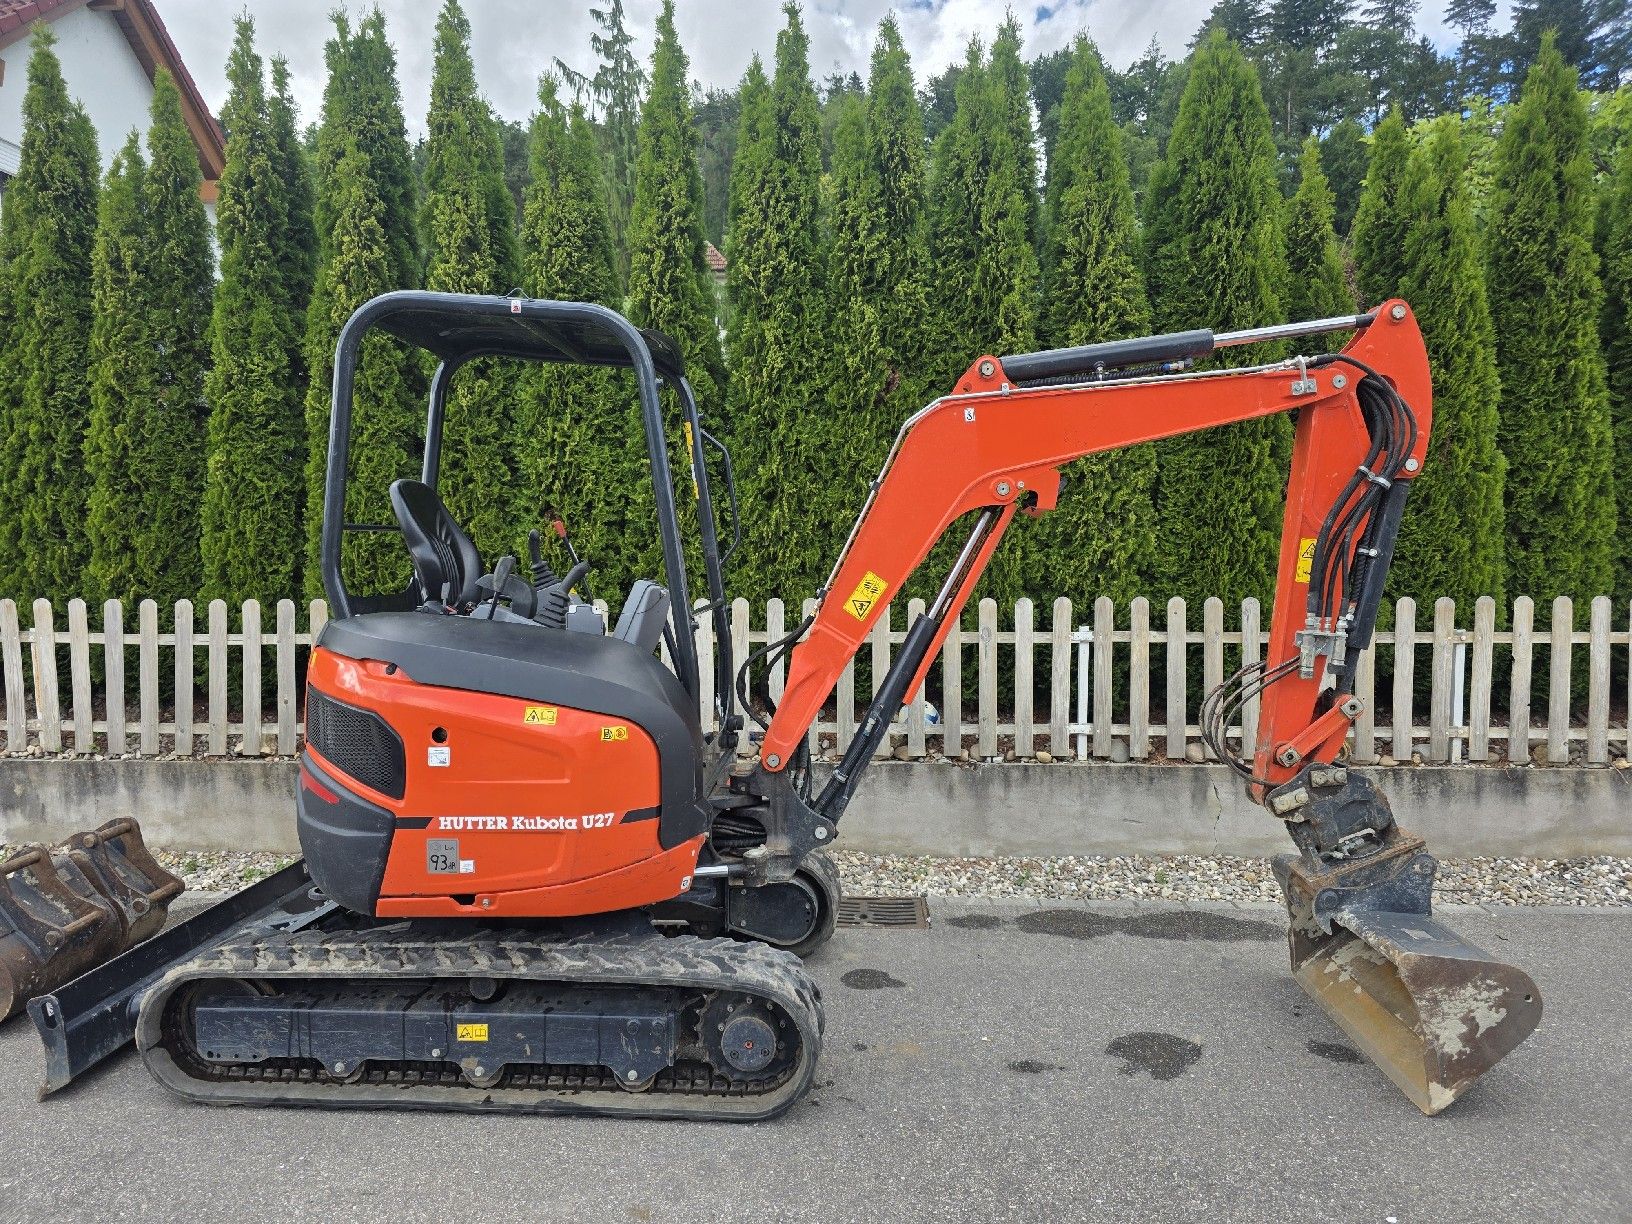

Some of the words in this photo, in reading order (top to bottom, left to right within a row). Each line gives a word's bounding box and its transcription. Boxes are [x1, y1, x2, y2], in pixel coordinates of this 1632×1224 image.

[438, 816, 508, 830] HUTTER
[511, 816, 578, 830] Kubota
[581, 812, 615, 829] U27
[430, 854, 448, 870] 93
